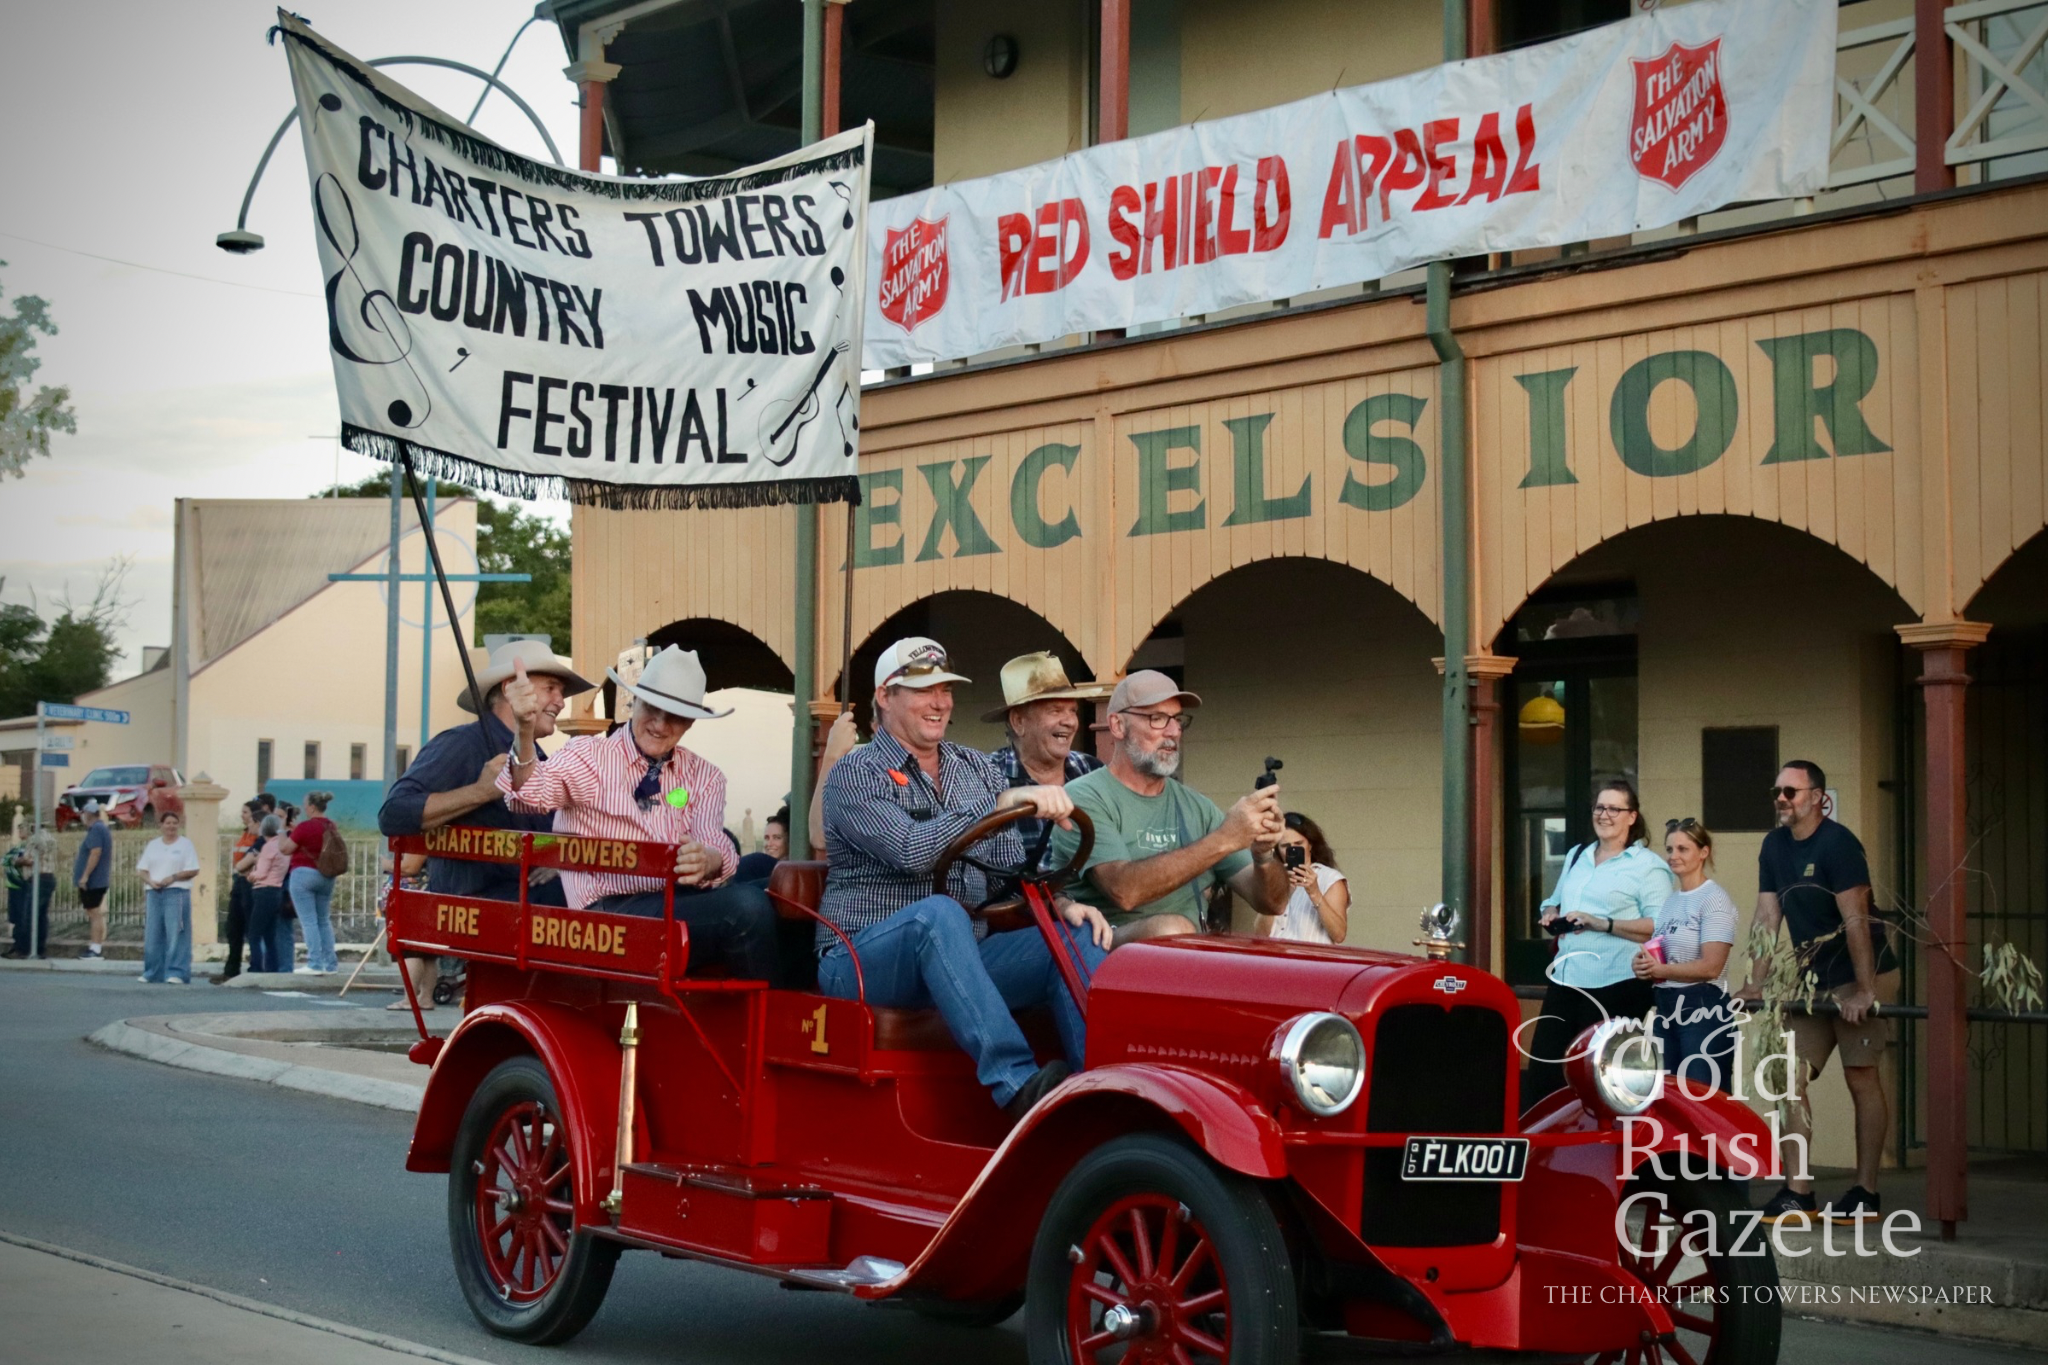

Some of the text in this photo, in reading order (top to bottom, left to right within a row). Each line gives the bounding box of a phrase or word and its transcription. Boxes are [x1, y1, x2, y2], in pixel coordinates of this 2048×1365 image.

[1633, 50, 1715, 163] SALVATION
[1646, 52, 1684, 108] THE
[1661, 95, 1716, 178] ARMY
[358, 116, 828, 267] CHARTERS TOWERS
[997, 102, 1540, 303] RED SHIELD APPEAL
[881, 226, 945, 309] SALVATION
[890, 224, 921, 266] THE
[396, 231, 816, 356] COUNTRY MUSIC
[902, 262, 943, 323] ARMY
[497, 370, 749, 465] FESTIVAL
[424, 828, 638, 869] CHARTERS TOWERS
[436, 903, 627, 955] FIRE BRIGADE
[811, 1003, 829, 1054] 1
